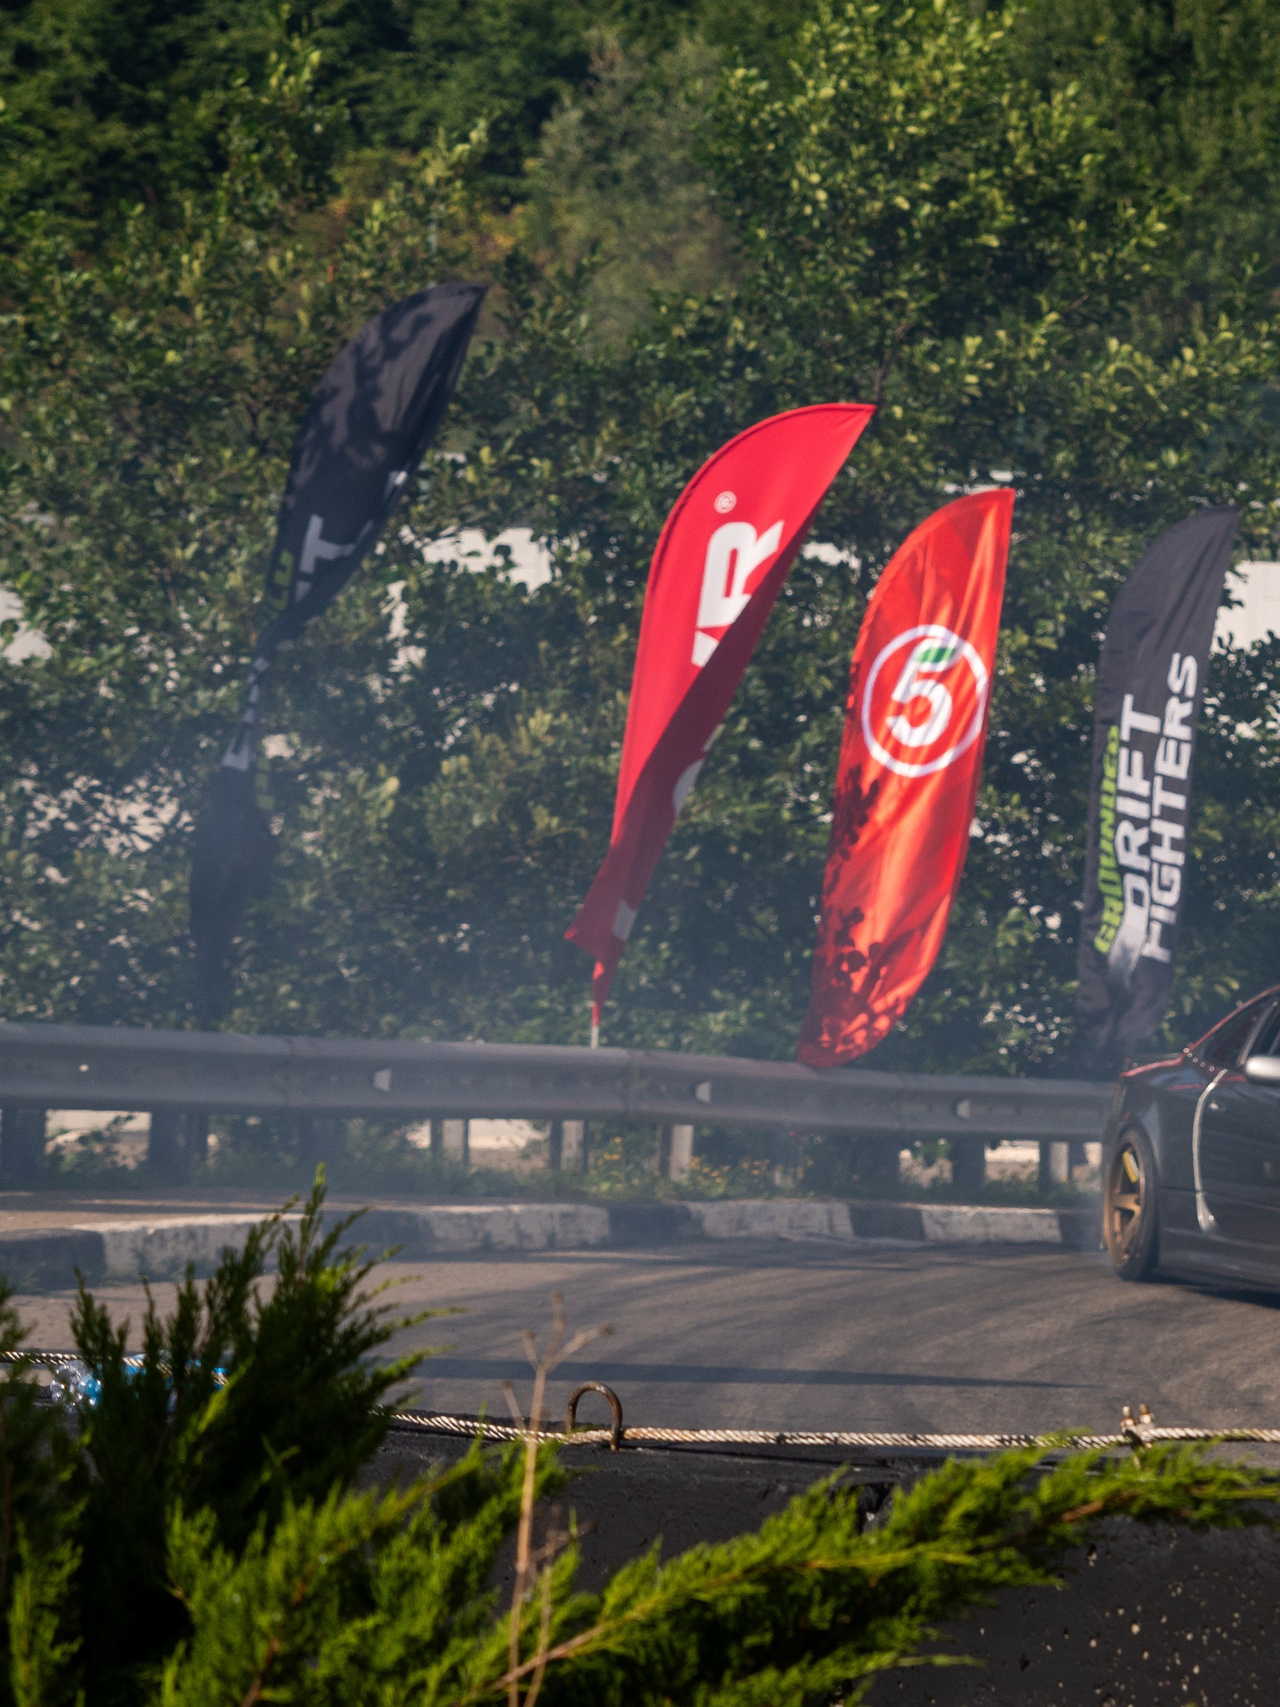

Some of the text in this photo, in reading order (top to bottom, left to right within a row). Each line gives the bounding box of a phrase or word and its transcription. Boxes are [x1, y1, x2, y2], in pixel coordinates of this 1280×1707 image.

[886, 637, 966, 747] 5
[1141, 652, 1198, 964] FIGHTERS
[1108, 694, 1161, 980] DRIFT
